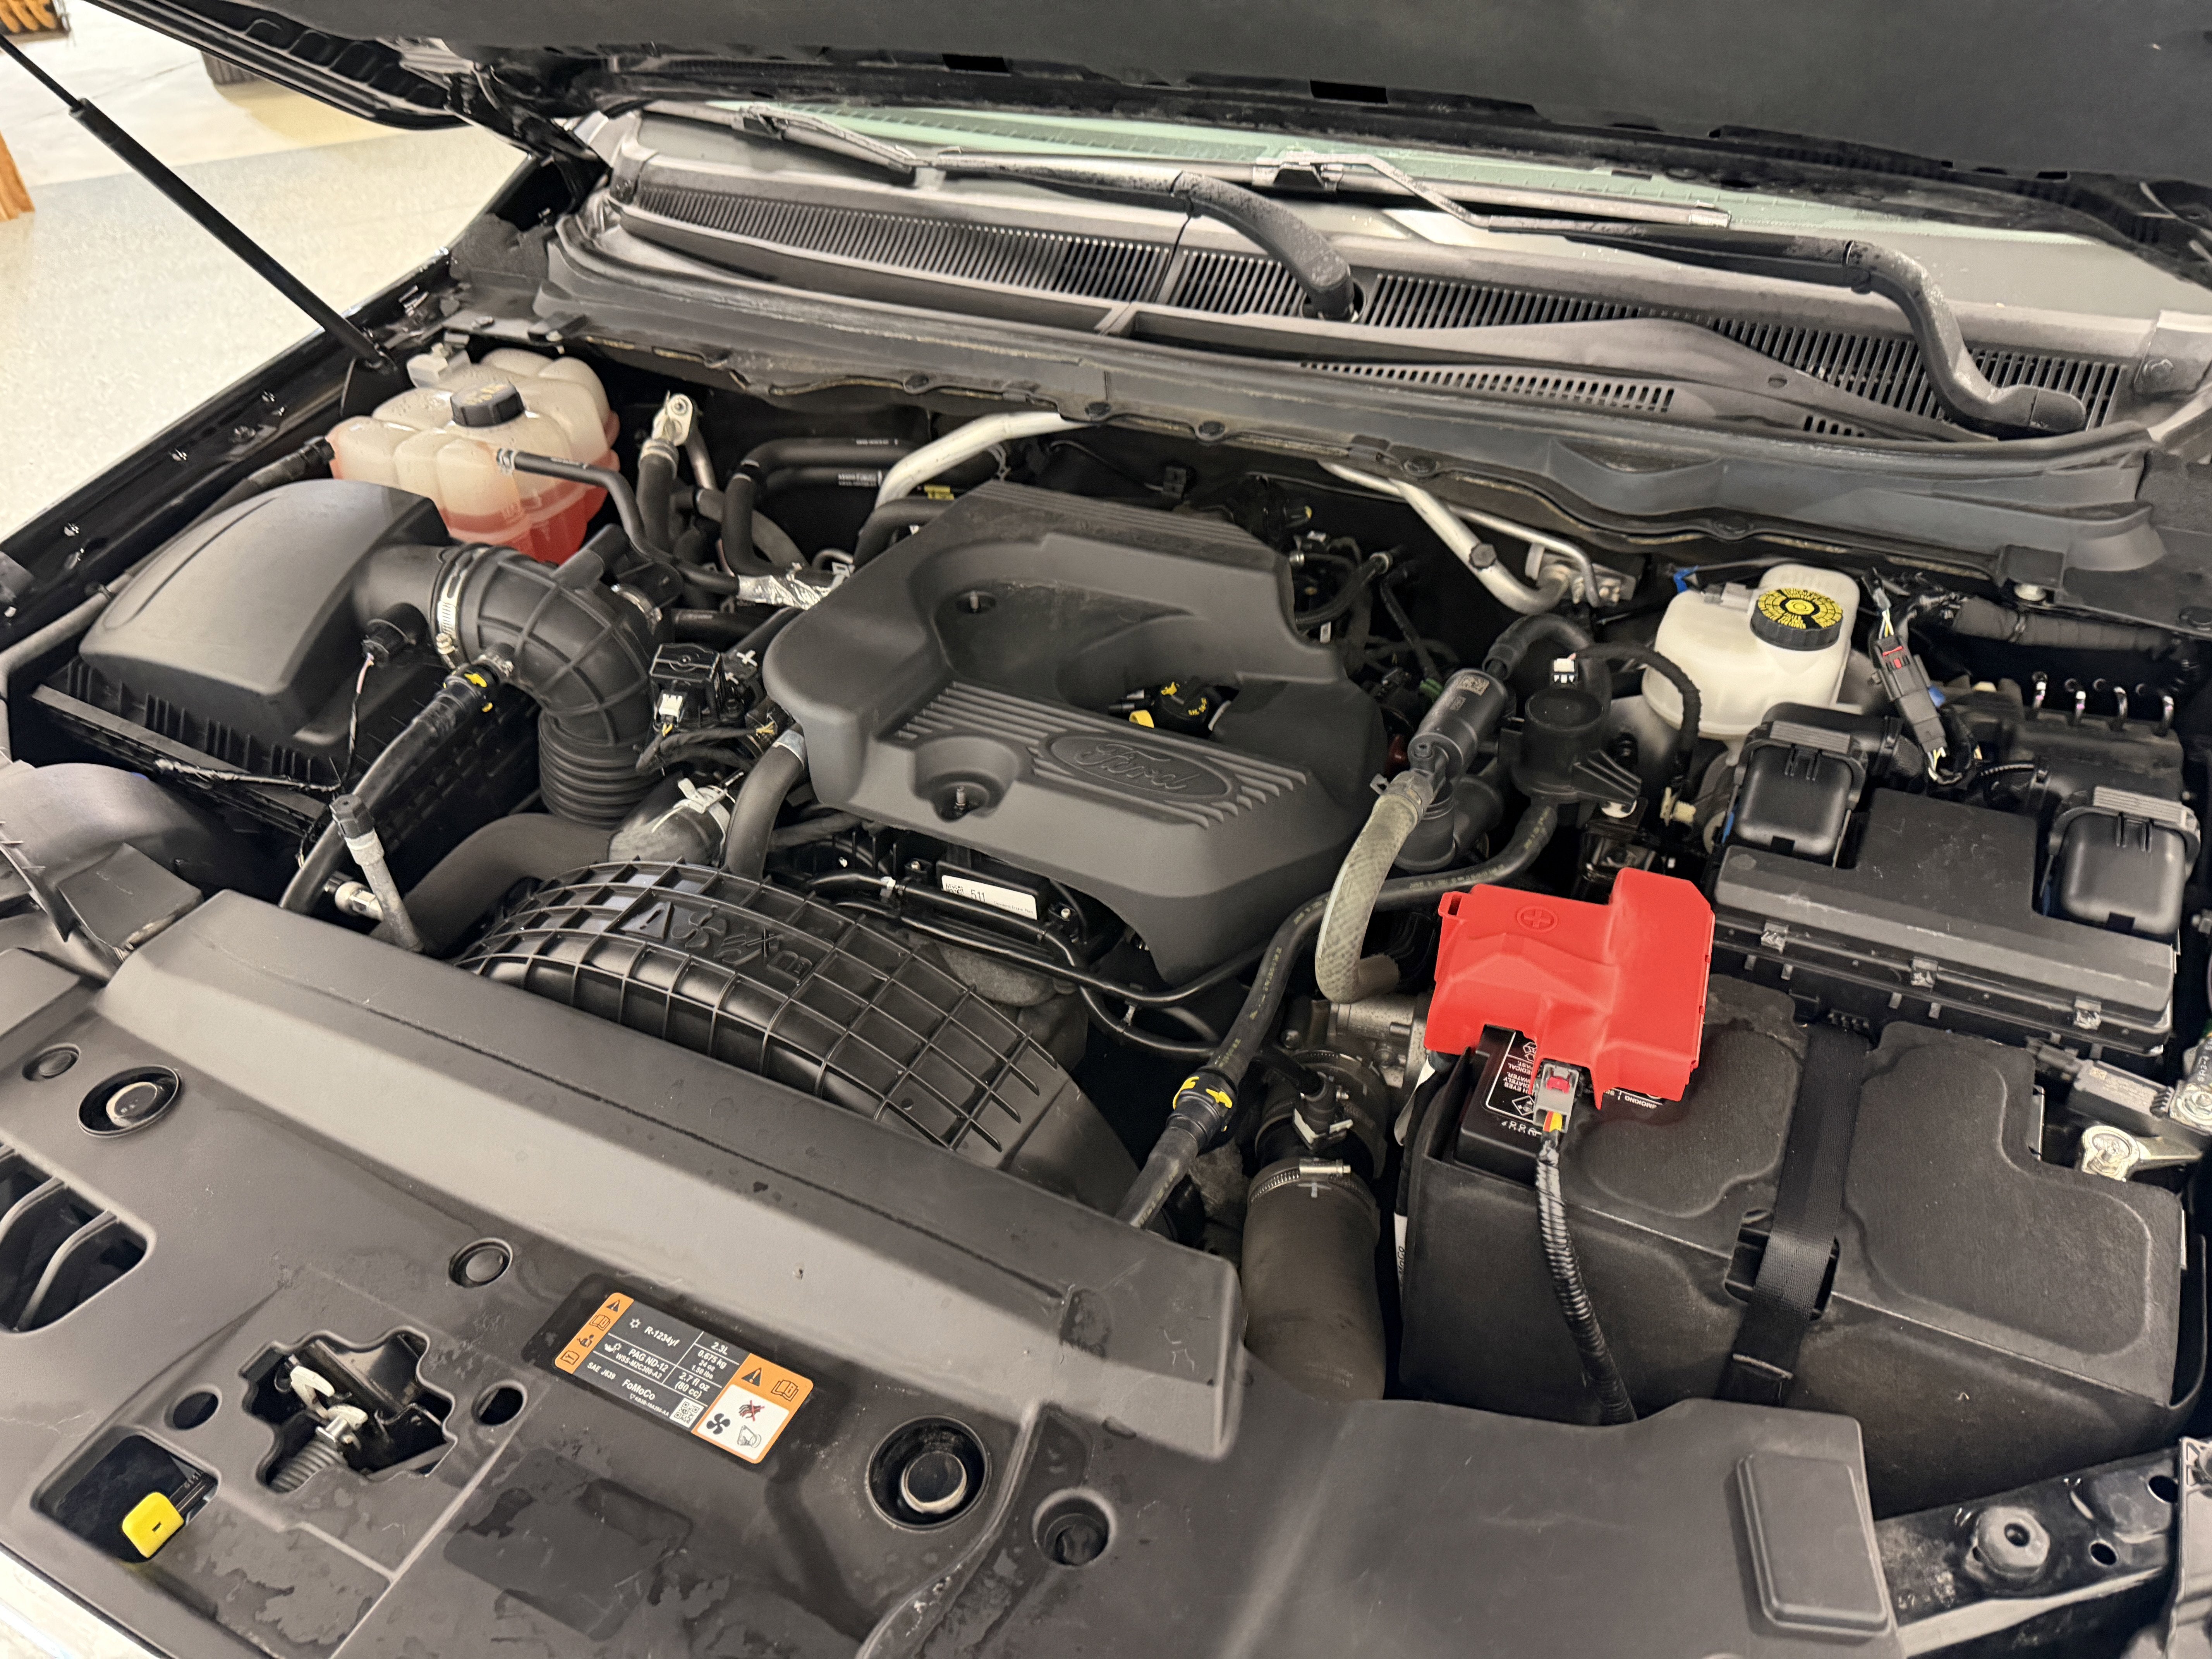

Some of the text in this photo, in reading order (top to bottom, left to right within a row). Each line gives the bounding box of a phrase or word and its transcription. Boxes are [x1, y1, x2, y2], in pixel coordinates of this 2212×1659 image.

[1074, 743, 1200, 790] Ford
[971, 889, 986, 902] 511
[1508, 1063, 1532, 1075] EDICAL
[644, 1326, 680, 1347] R-1234yf
[711, 1341, 728, 1355] 2.3L
[628, 1348, 669, 1373] PAG ND-12
[698, 1350, 727, 1369] 0.675 kg
[587, 1362, 616, 1380] SAE J639
[692, 1365, 714, 1379] 1.50 lbs
[622, 1379, 656, 1401] FoMoCo
[675, 1380, 702, 1400] (80 cc)
[679, 1372, 694, 1382] 2.7
[699, 1382, 710, 1392] oz
